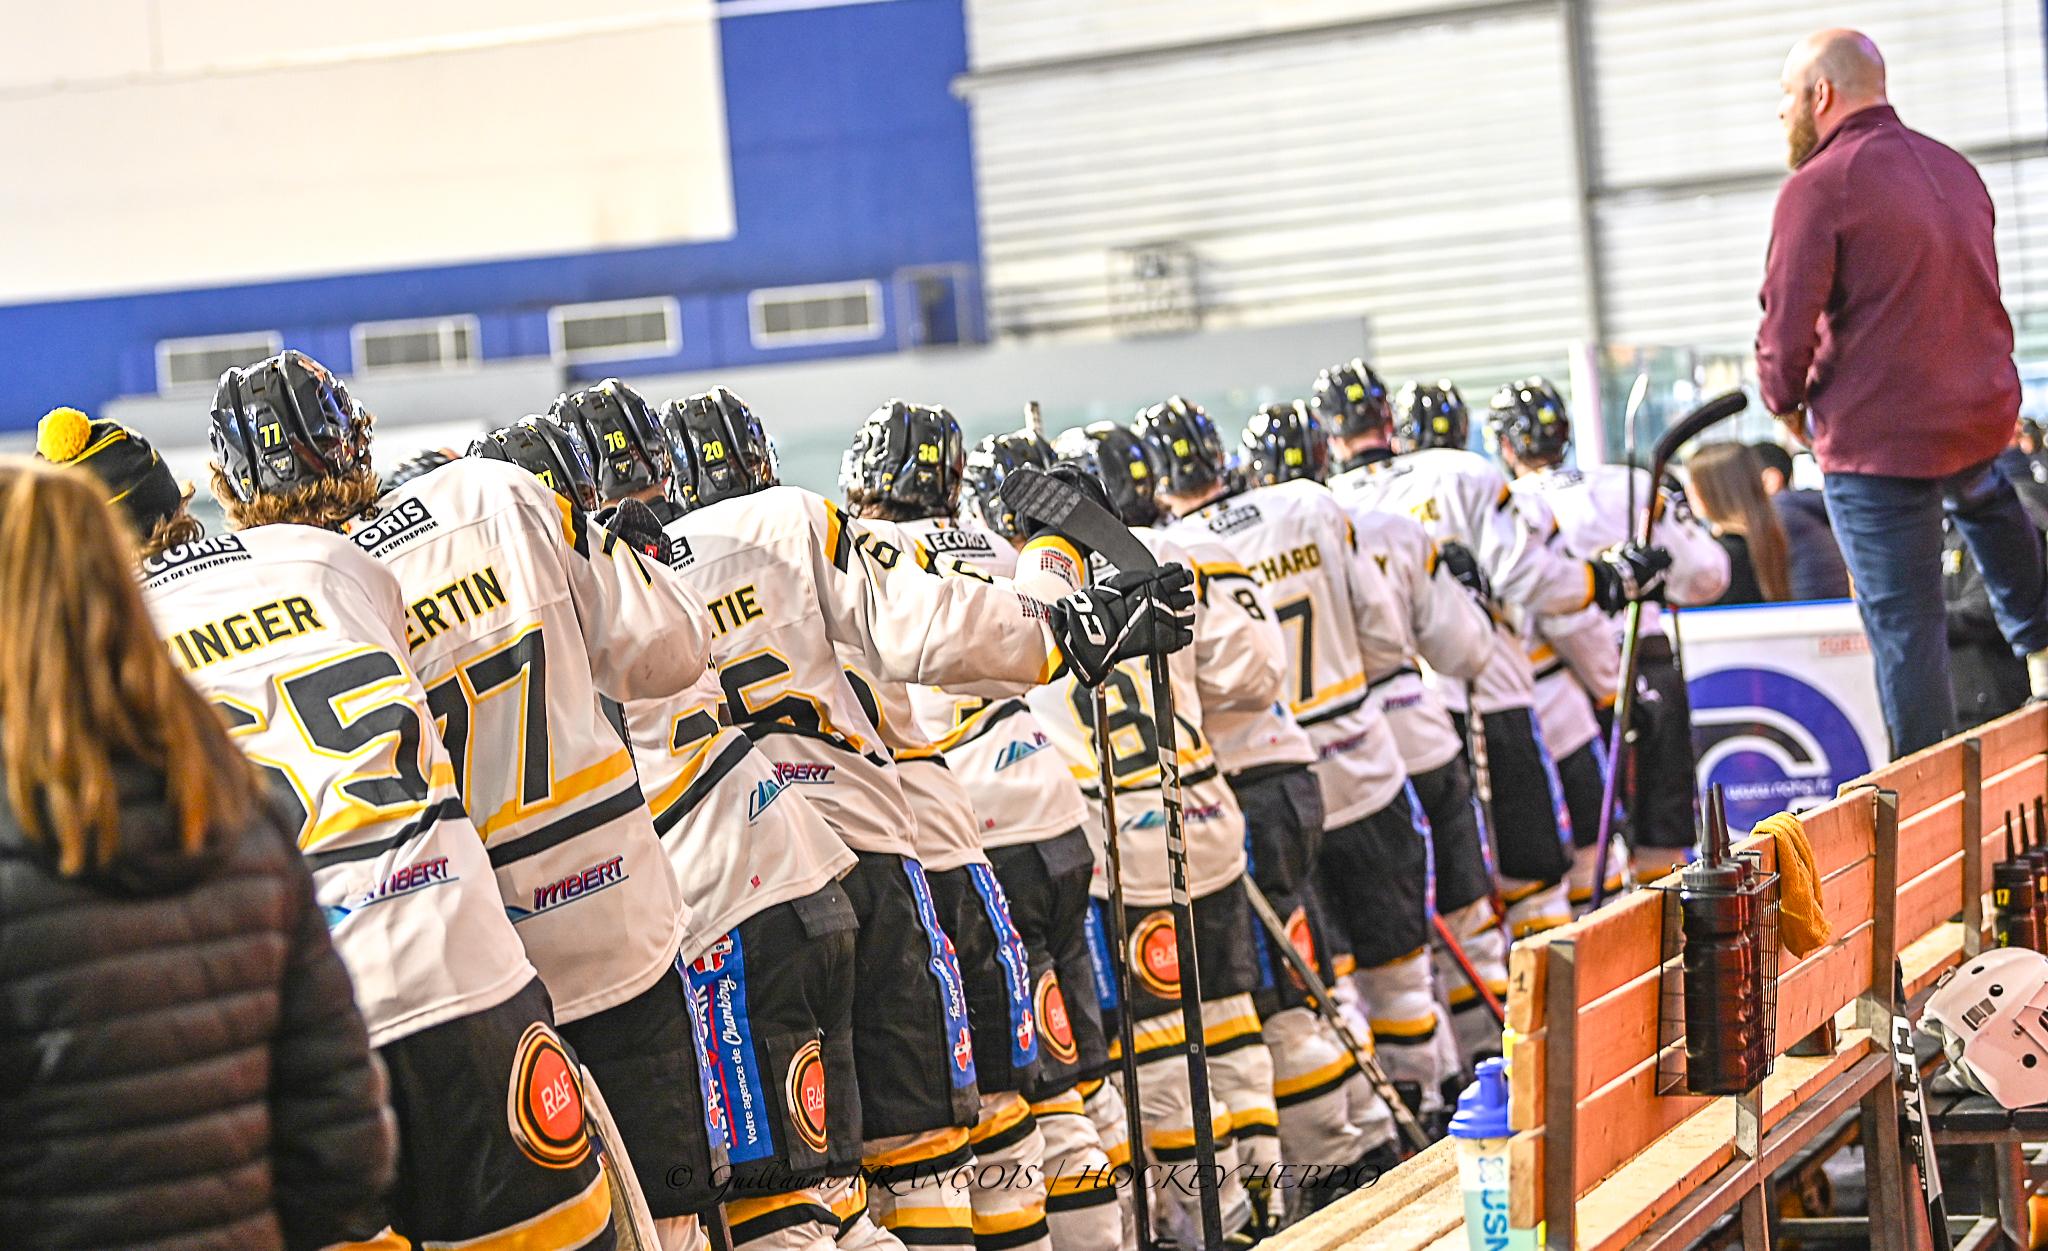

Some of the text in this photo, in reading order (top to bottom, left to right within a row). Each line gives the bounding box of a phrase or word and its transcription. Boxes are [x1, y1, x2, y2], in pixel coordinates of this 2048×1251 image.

[259, 422, 280, 448] 77
[604, 431, 626, 453] 76
[703, 441, 724, 462] 20
[707, 584, 764, 639] TIE
[170, 595, 326, 673] INGER
[731, 1048, 742, 1064] de
[541, 1070, 571, 1121] RAF
[736, 1066, 753, 1109] agence
[745, 1112, 758, 1145] Votre
